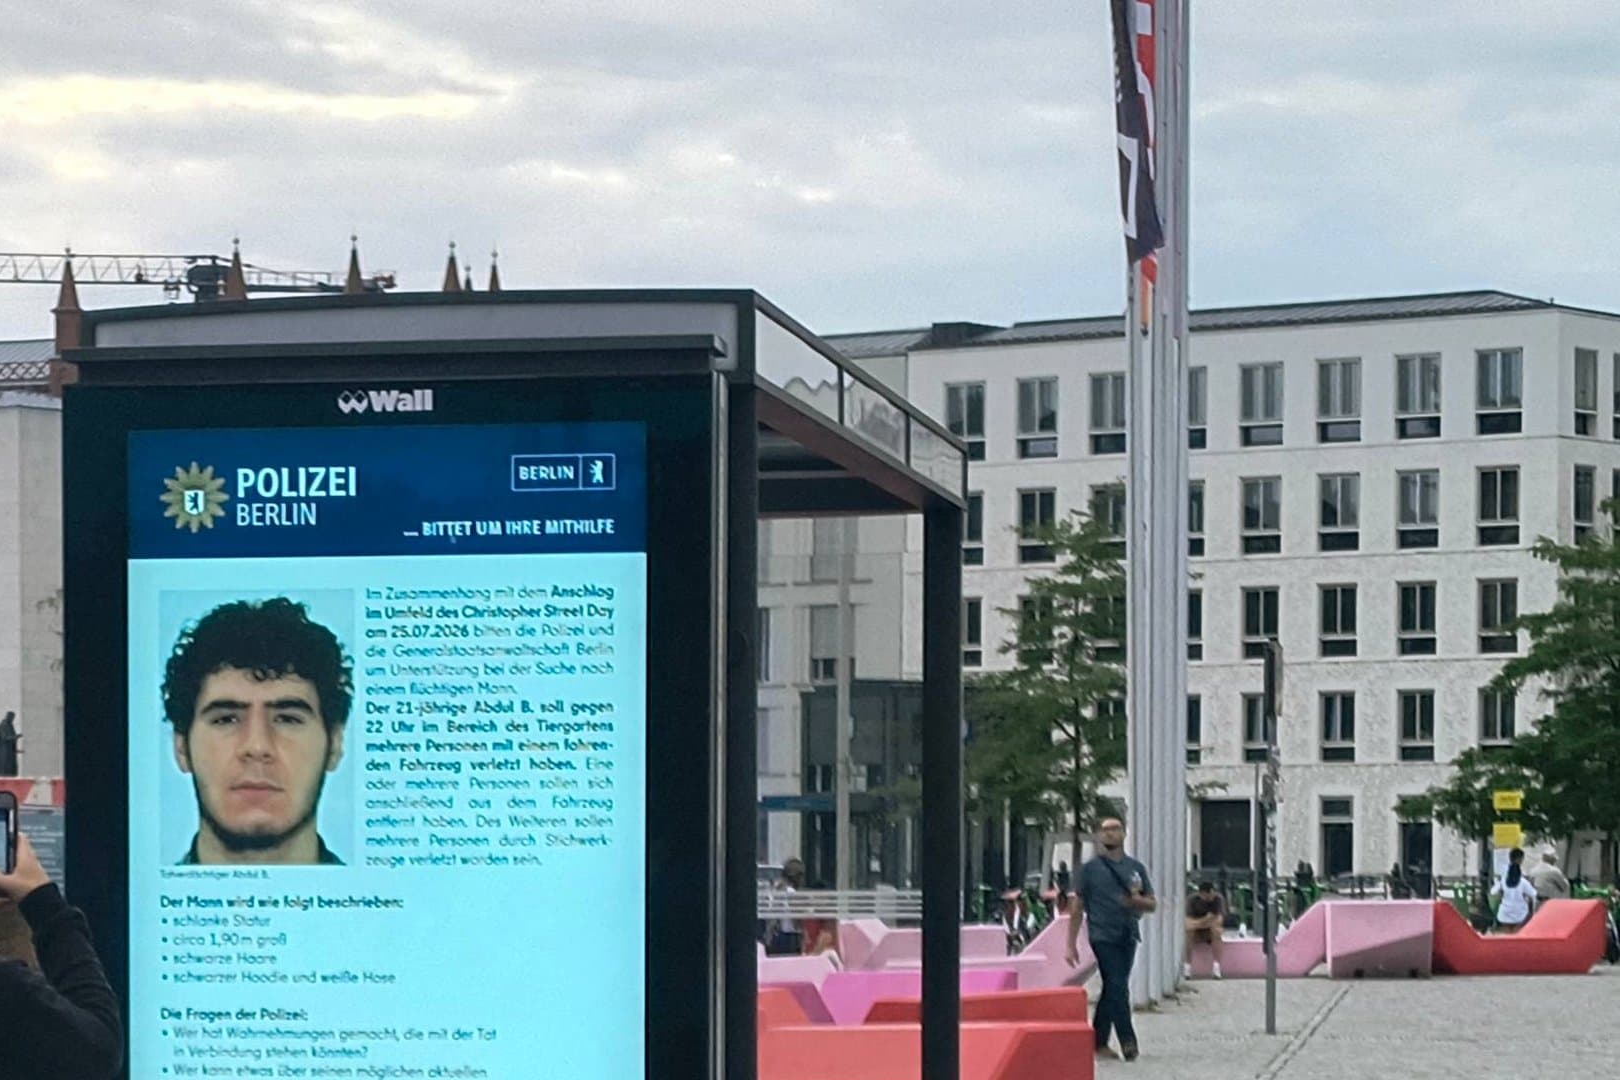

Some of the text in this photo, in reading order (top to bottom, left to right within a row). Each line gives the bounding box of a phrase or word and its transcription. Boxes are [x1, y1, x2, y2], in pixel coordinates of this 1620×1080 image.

[368, 389, 433, 412] Wall
[519, 466, 575, 481] BERLIN
[237, 466, 356, 498] POLIZEI
[236, 502, 317, 526] BERLIN
[422, 519, 615, 537] BITTET UM IHRE MITHILFE
[550, 584, 614, 600] Anschlag
[364, 603, 615, 620] im Umfeld des Christopher Street Day
[390, 624, 469, 638] 25.07.2026
[364, 699, 614, 716] Der 21-jährige Abdul B. soll gegen
[364, 718, 614, 734] 22 Uhr im Bereich des Tiergartens
[364, 739, 421, 752] mehrere
[425, 738, 488, 752] Personen
[491, 738, 513, 751] mit
[517, 738, 559, 751] einem
[364, 758, 391, 771] den
[399, 757, 462, 773] Fahrzeug
[469, 757, 521, 770] verletzt
[528, 756, 577, 770] haben.
[159, 894, 403, 910] Der Mann wird wie folgt beschrieben:
[159, 1007, 308, 1022] Die Fragen der Polizei:
